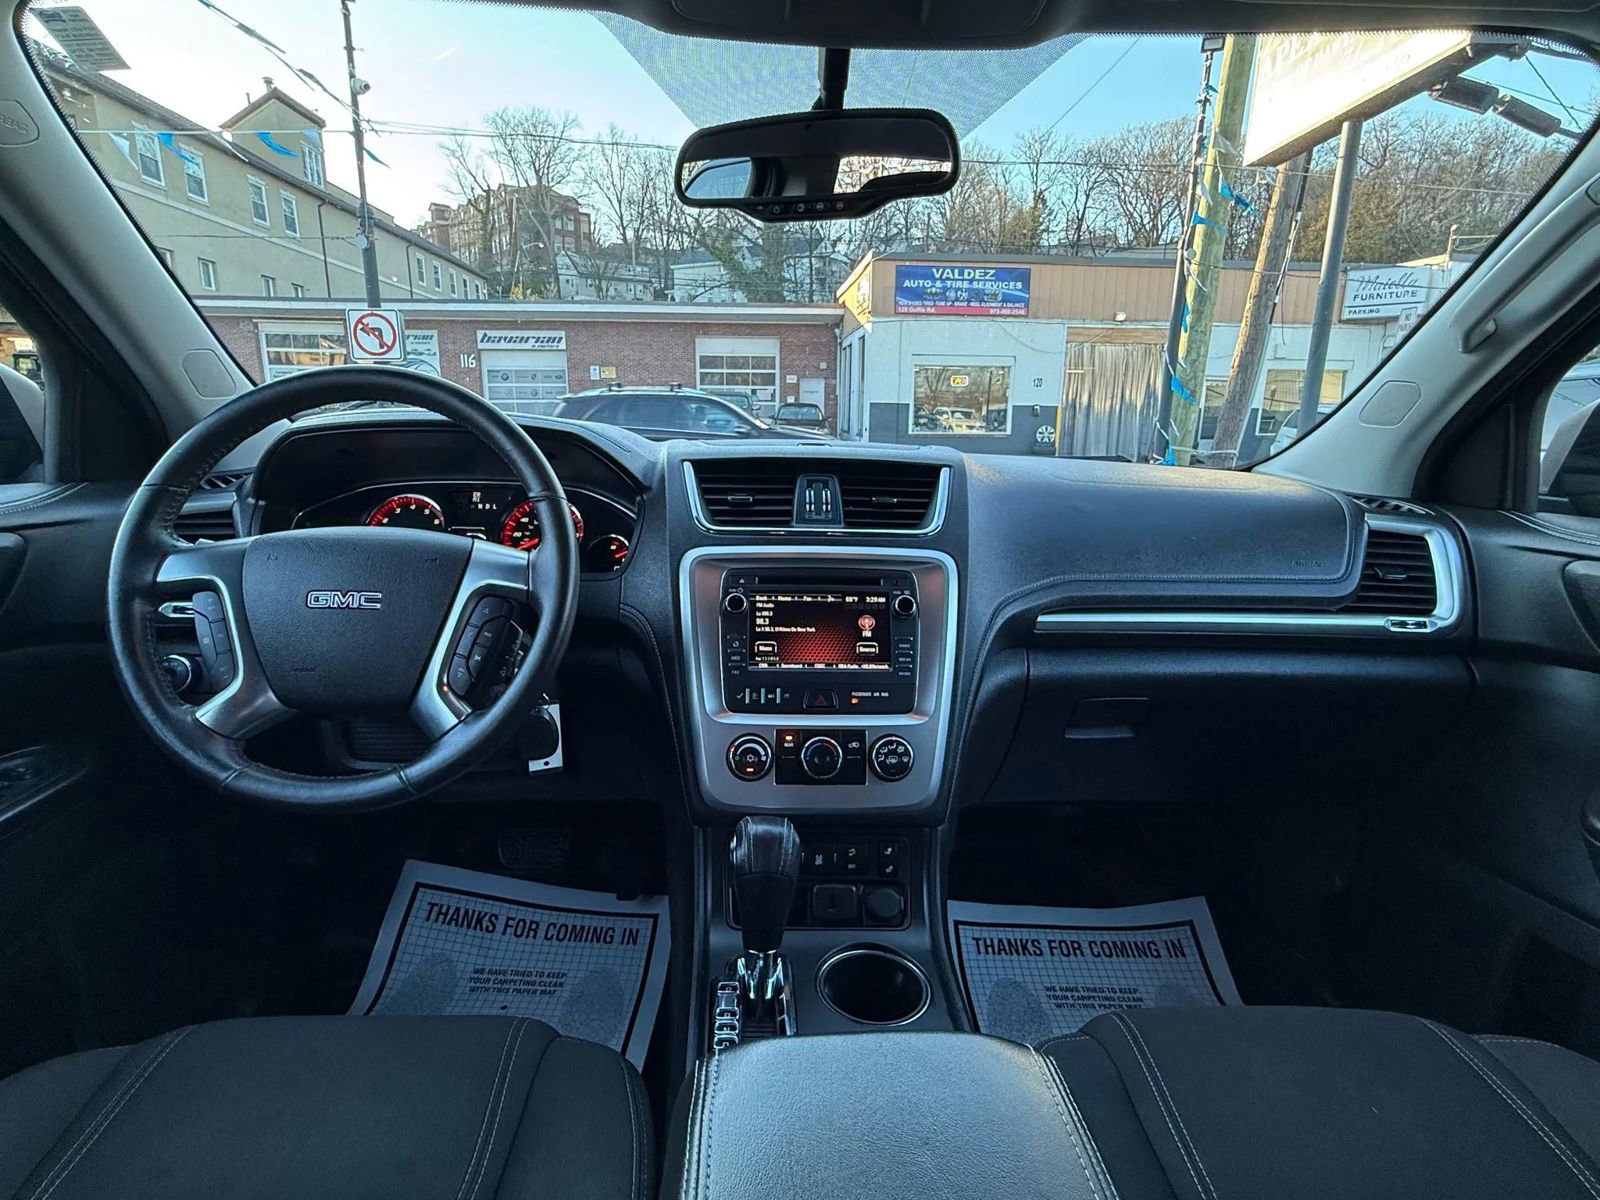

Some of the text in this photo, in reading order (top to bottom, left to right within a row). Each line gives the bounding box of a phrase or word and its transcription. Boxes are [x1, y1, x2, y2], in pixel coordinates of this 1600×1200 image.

[932, 268, 996, 280] VALDEZ
[903, 279, 1023, 289] AUTO & TIRE SERVICES
[1353, 289, 1418, 302] FURNITURE
[480, 331, 564, 344] bavarian
[460, 354, 476, 368] 116
[307, 590, 382, 610] GMC
[425, 902, 640, 946] THANKS FOR COMING IN
[972, 937, 1186, 960] THANKS FOR COMING IN
[473, 967, 487, 975] WE
[487, 968, 508, 976] HAVE
[510, 969, 534, 978] TRIED
[546, 971, 567, 979] KEEP
[468, 976, 565, 988] YOUR CARPETING CLEAN
[511, 987, 538, 995] PAPER
[1059, 985, 1079, 993] HAVE
[1071, 994, 1116, 1002] CARPETING
